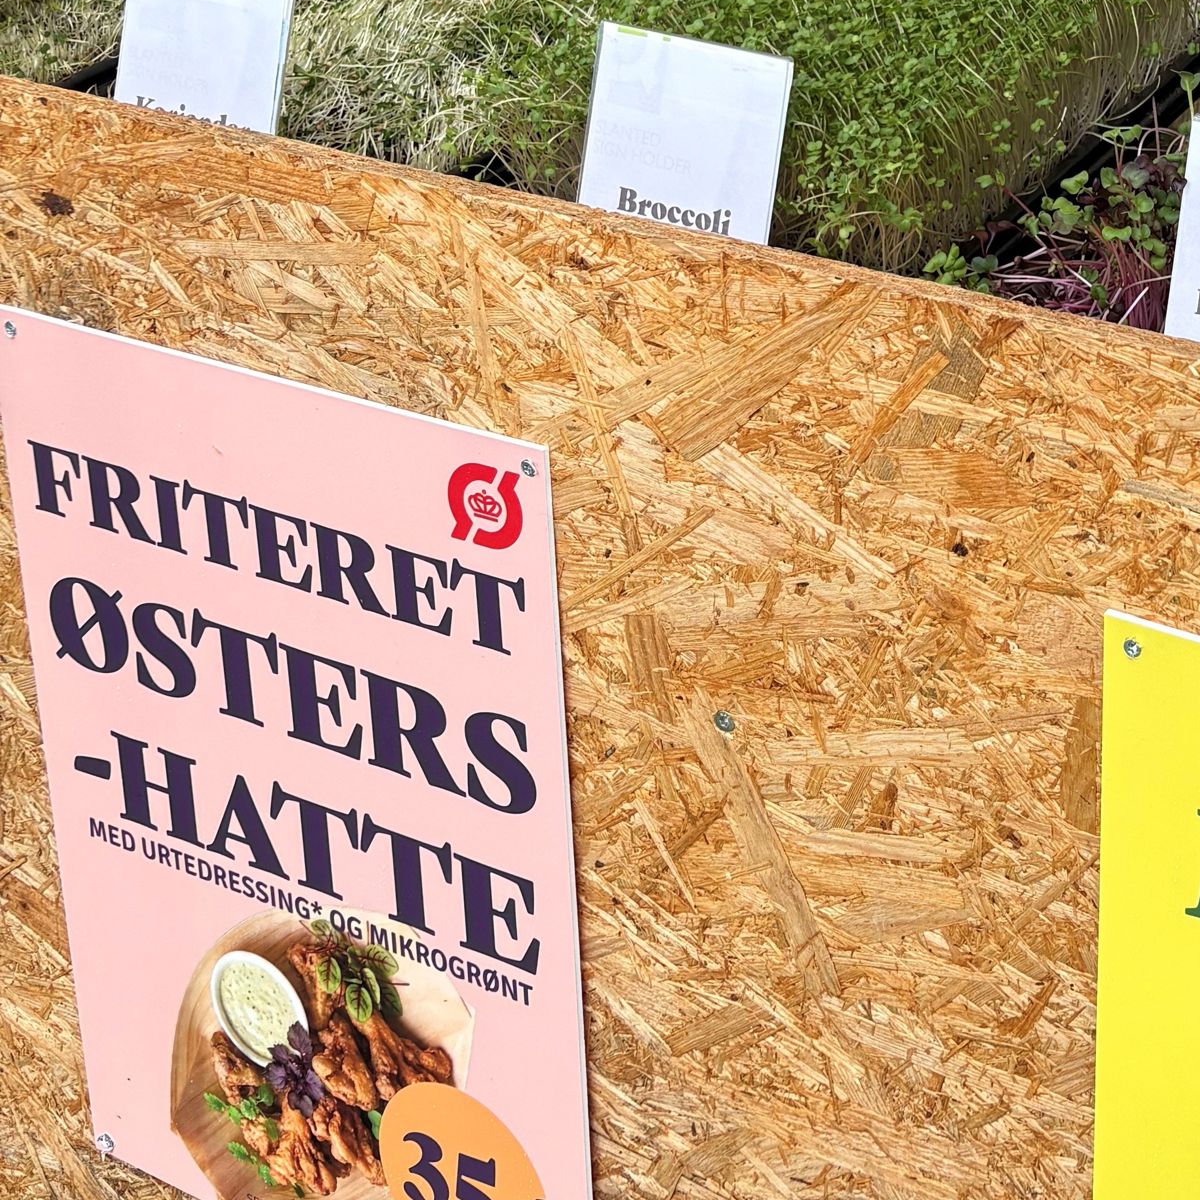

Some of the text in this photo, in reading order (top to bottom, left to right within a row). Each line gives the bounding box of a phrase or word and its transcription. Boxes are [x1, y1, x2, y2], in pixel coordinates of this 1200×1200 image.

[617, 186, 732, 235] Broccoli
[27, 440, 525, 655] FRITERET
[49, 577, 537, 815] ØSTERS
[74, 731, 541, 974] -HATTE
[89, 817, 136, 852] MED
[330, 910, 363, 940] OG
[370, 924, 533, 1007] MIKROGRØNT
